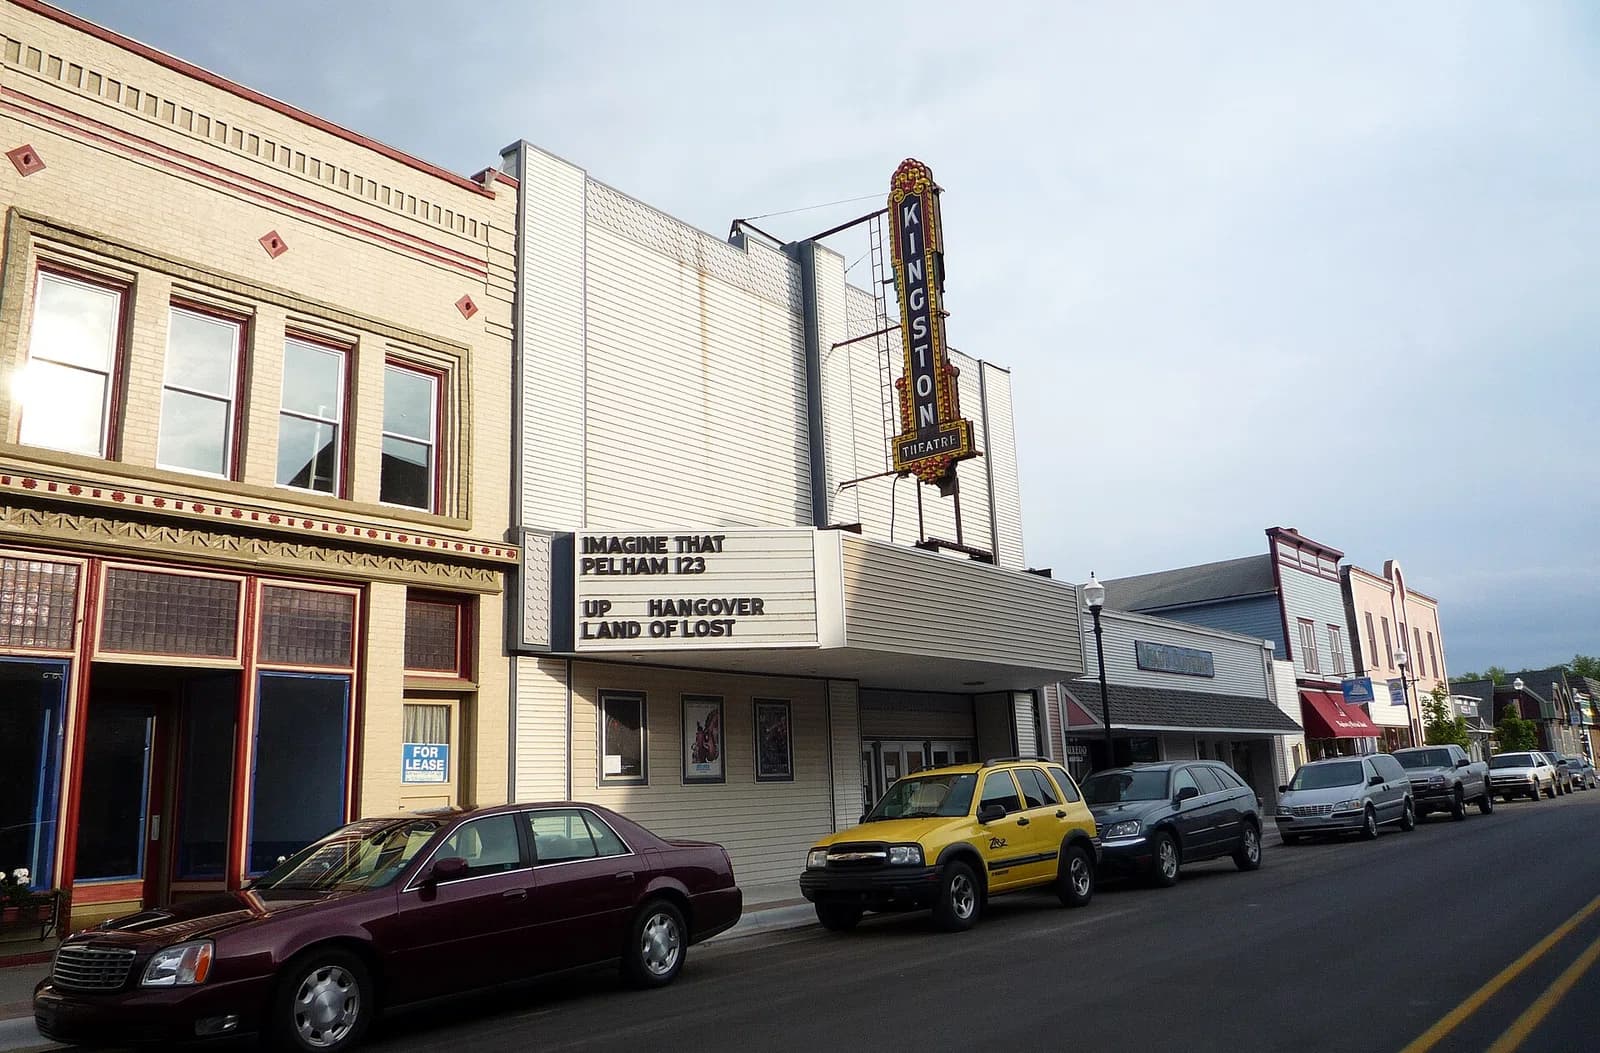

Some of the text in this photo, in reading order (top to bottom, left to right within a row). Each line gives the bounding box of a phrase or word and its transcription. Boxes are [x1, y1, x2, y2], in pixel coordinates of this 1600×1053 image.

[903, 202, 935, 429] KINGSTON
[902, 434, 957, 457] THEATRE
[582, 534, 726, 555] IMAGINE THAT
[580, 556, 706, 576] PELHAM 123
[583, 597, 765, 618] UP HANGOVER
[580, 618, 736, 640] LAND OF LOST
[413, 746, 439, 758] FOR
[405, 758, 445, 771] LEASE
